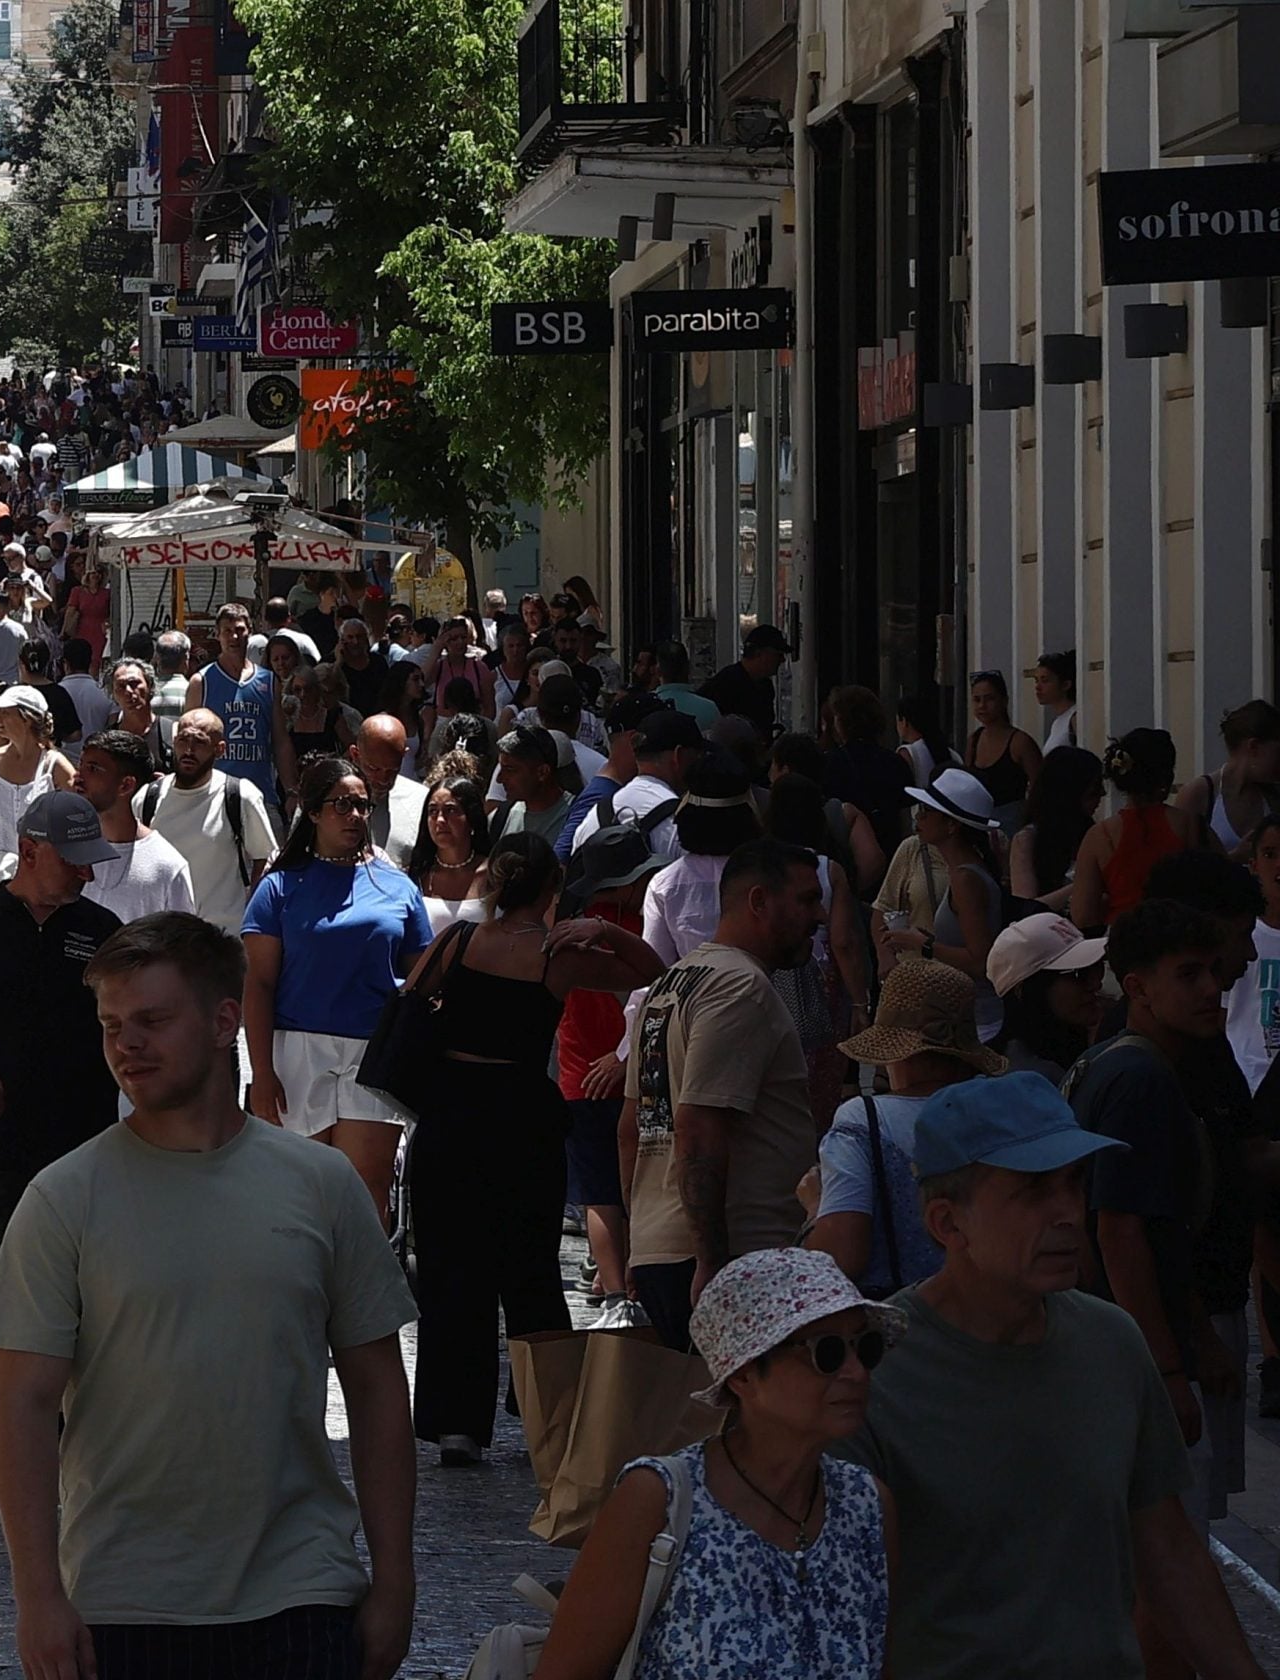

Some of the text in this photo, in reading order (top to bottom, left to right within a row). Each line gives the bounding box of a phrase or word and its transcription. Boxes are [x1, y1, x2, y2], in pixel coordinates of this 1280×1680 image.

[514, 311, 587, 346] BSB
[644, 306, 760, 338] parabita
[269, 329, 342, 351] Center
[224, 700, 261, 716] NORTH
[228, 716, 257, 740] 23
[220, 743, 266, 762] AROLIN
